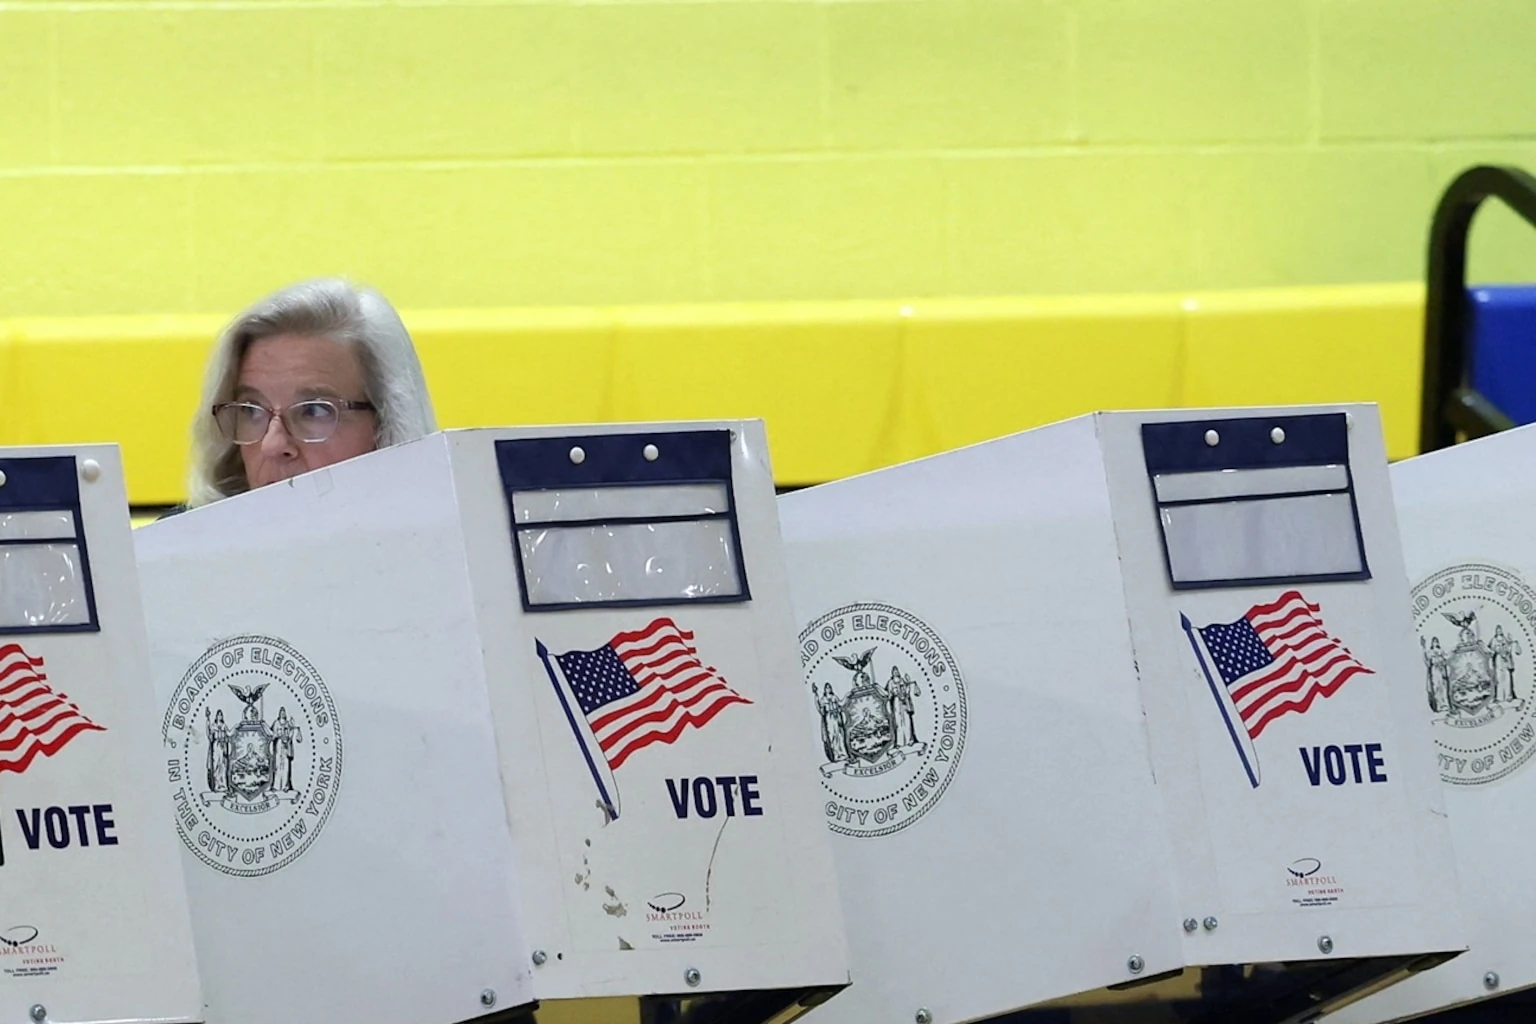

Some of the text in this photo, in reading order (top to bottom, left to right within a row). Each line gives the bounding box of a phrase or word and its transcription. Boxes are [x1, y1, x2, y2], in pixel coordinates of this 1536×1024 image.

[1431, 577, 1454, 598] OF
[820, 618, 845, 642] OF
[851, 614, 946, 677] ELECTIONS
[172, 647, 330, 730] BOARD OF ELECTIONS
[825, 702, 957, 825] CITY OF NEW YORK
[853, 759, 897, 775] EXCELSIOR
[1299, 743, 1388, 786] VOTE
[1471, 754, 1494, 773] OF
[1498, 723, 1535, 763] NEW
[168, 757, 333, 864] IN THE CITY OF NEW YORK
[229, 801, 272, 812] EXCELSIOR
[665, 775, 763, 819] VOTE
[16, 804, 119, 850] VOTE
[1286, 876, 1337, 886] SMARTPOLL
[646, 911, 703, 922] SMARTPOLL
